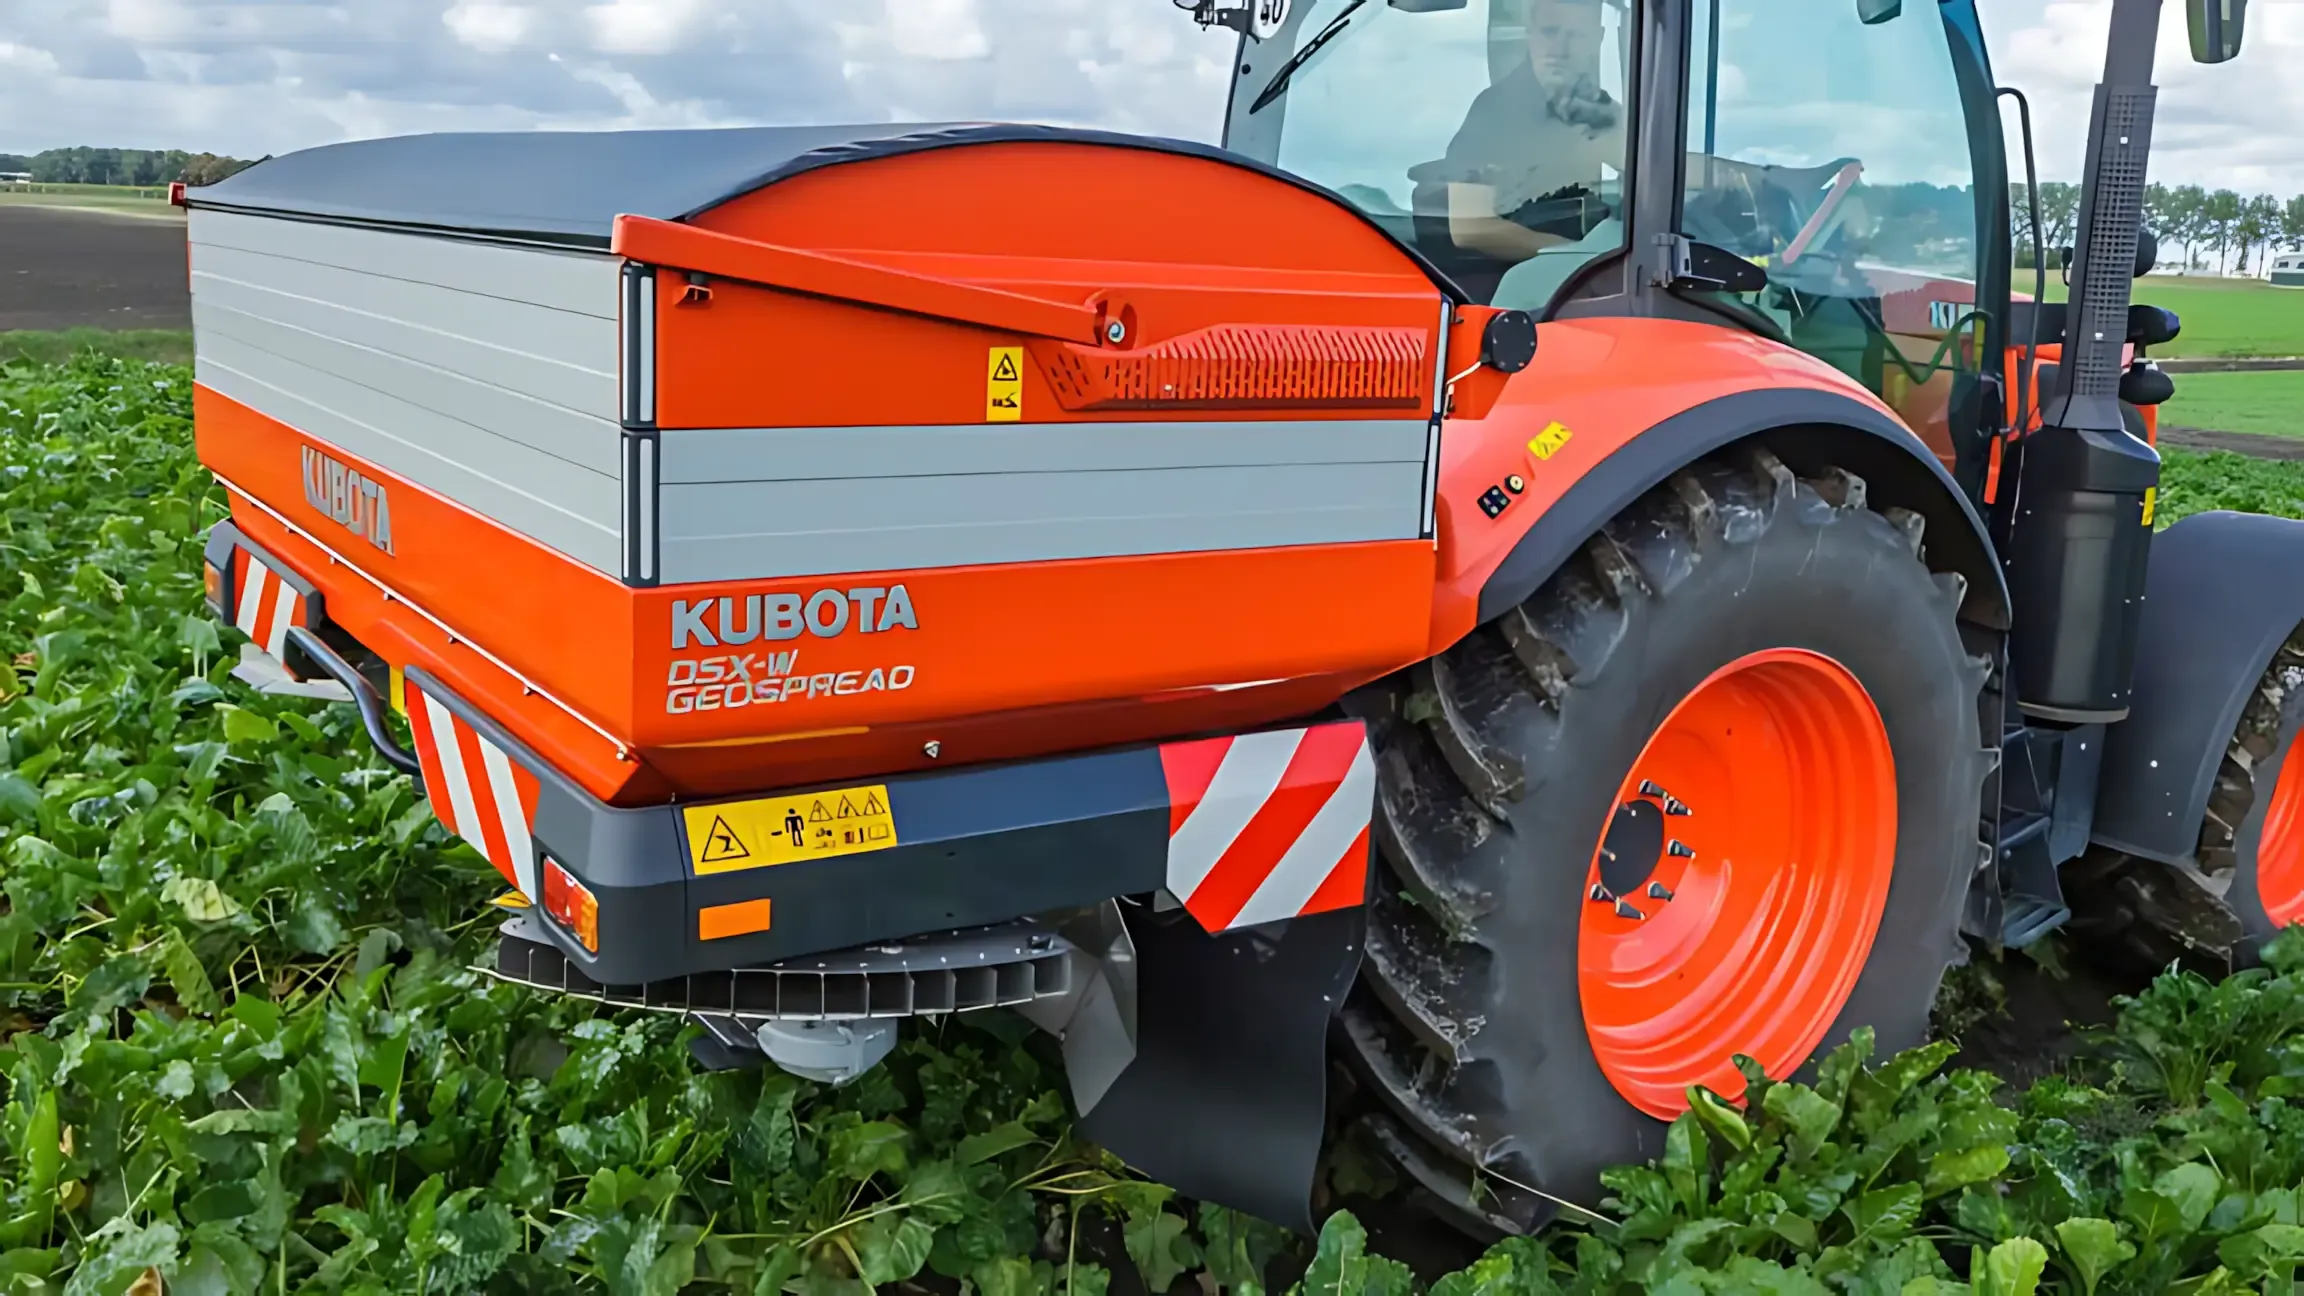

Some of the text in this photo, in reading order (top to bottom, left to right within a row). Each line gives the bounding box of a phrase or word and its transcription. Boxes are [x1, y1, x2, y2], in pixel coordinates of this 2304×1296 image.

[302, 444, 396, 558] KUBOTA
[671, 584, 919, 649] KUBOTA
[666, 665, 915, 714] GEOSPREAD
[667, 649, 798, 686] DSX-W
